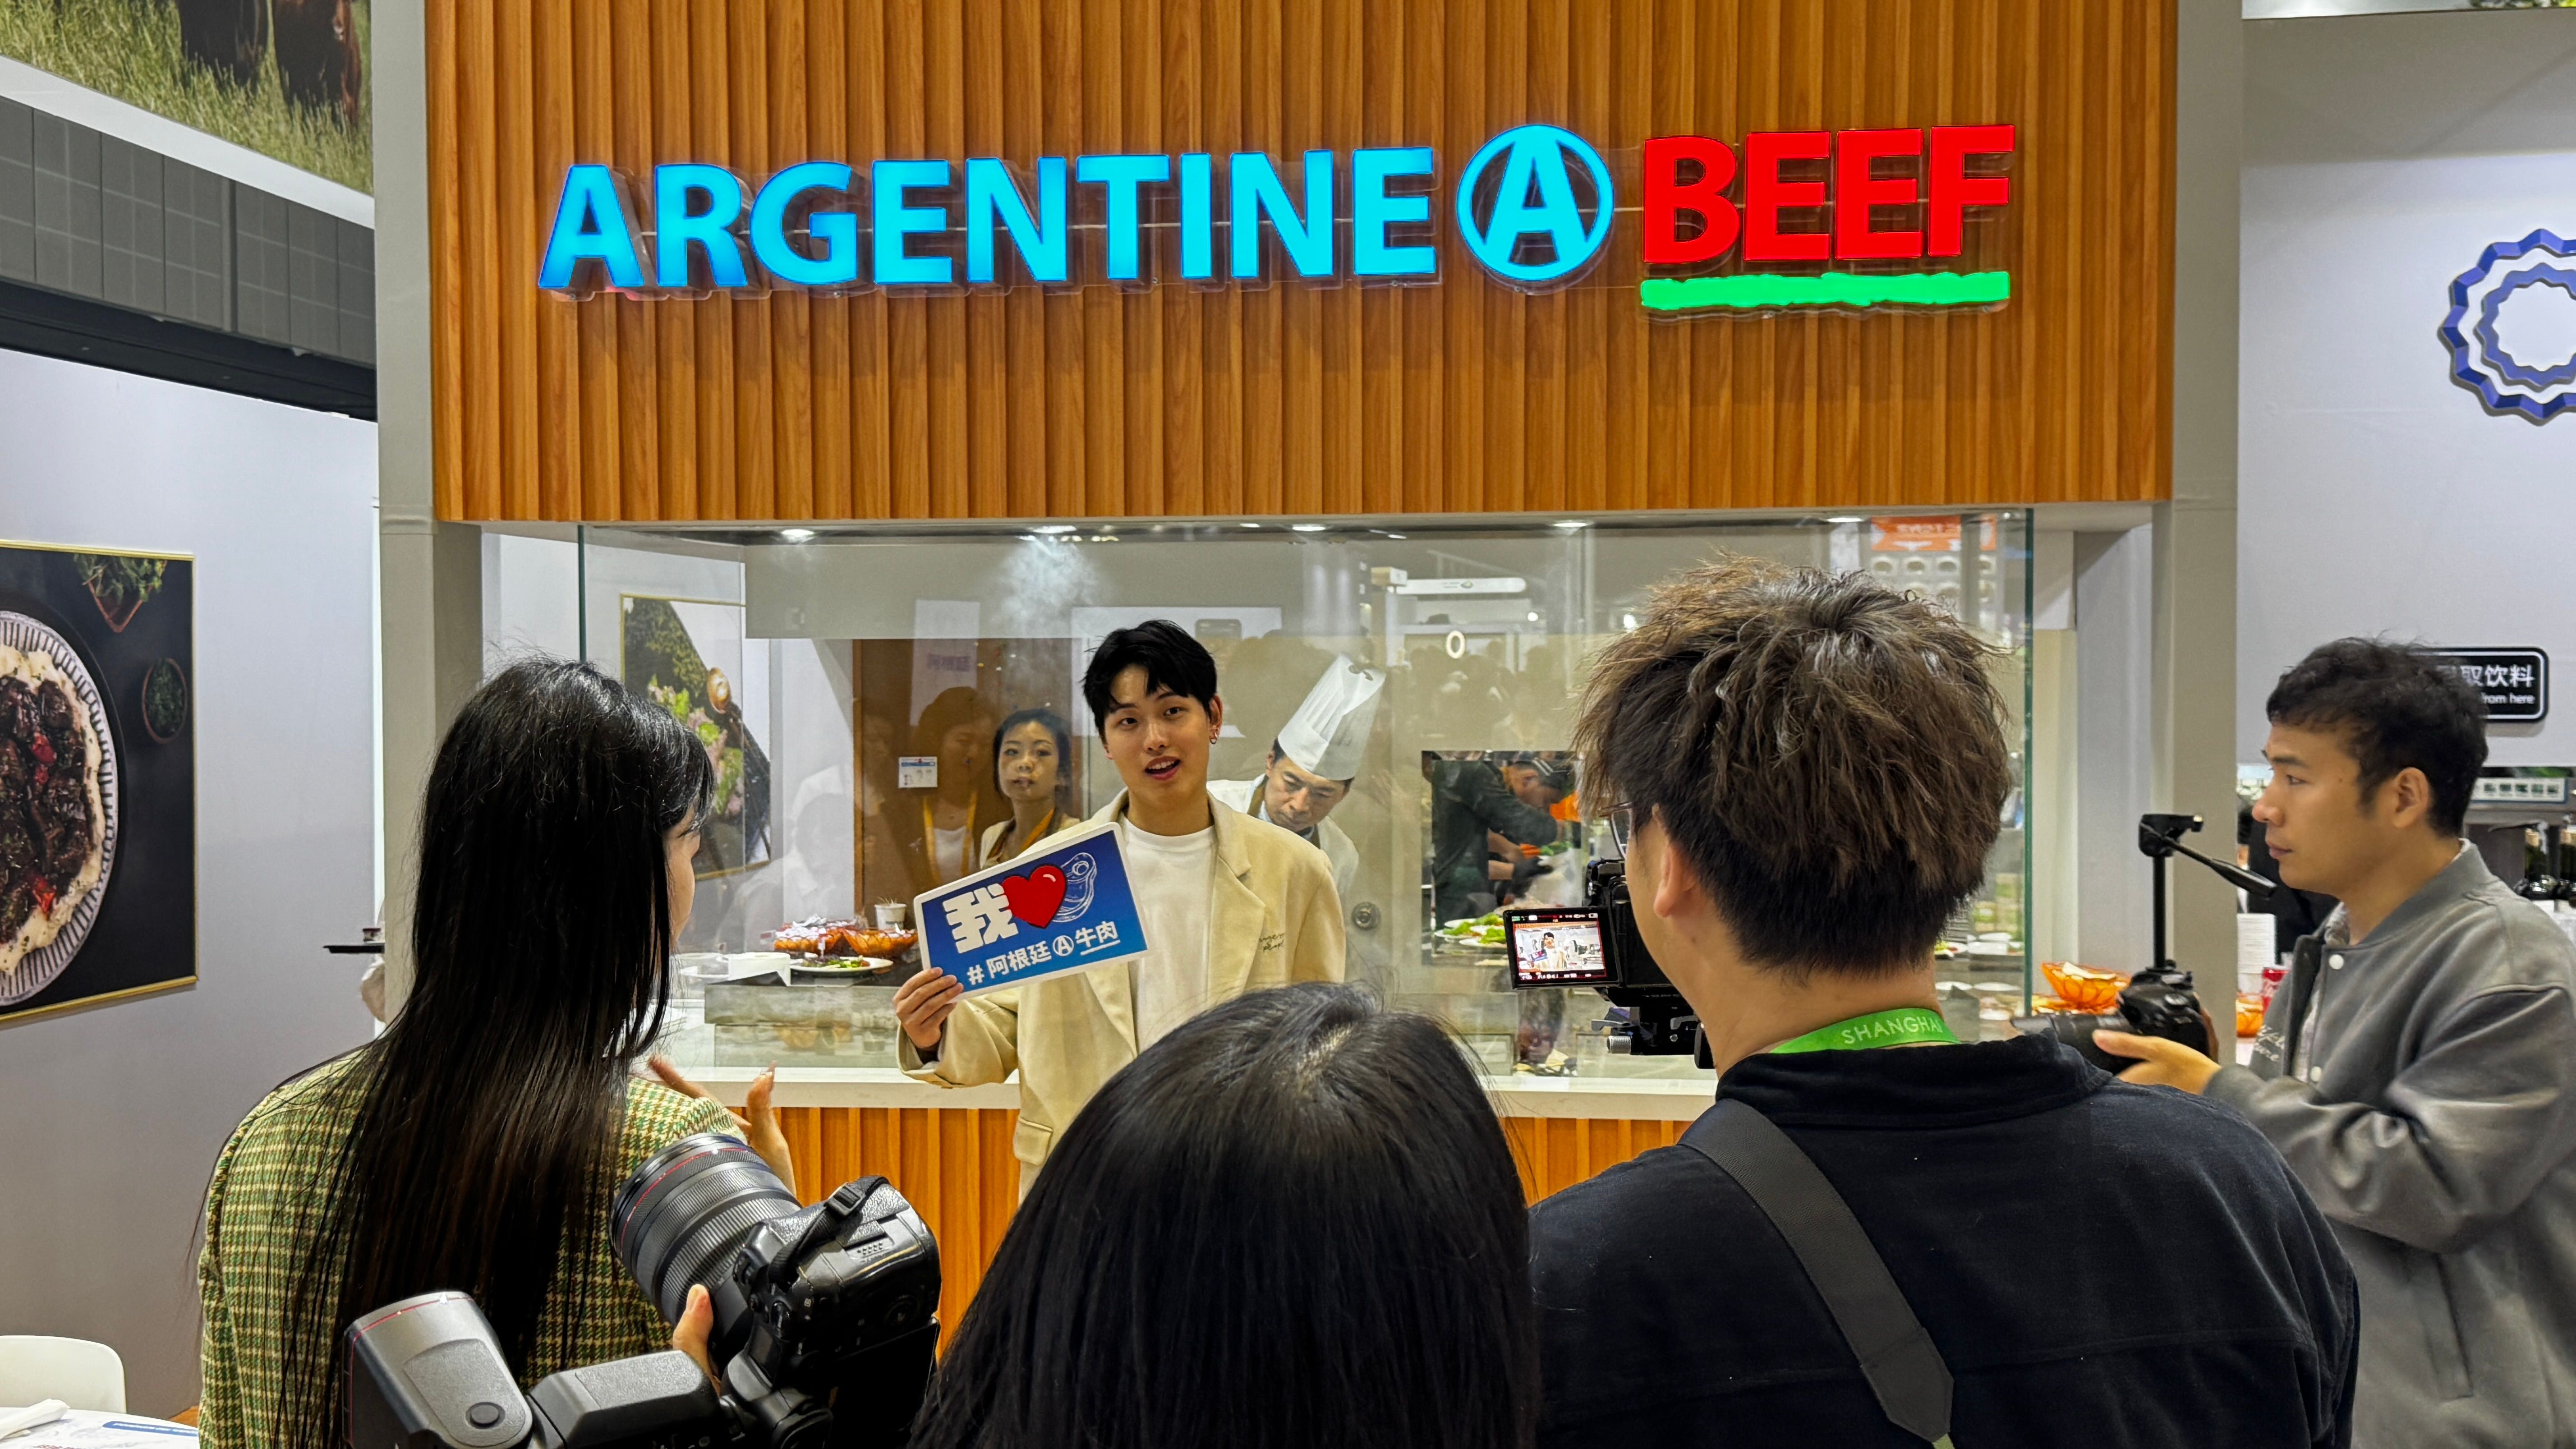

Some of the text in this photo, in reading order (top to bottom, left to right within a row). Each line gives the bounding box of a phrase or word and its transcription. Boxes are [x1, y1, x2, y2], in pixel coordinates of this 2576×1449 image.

[538, 124, 2015, 289] ARGENTINE A BEEF
[2509, 692, 2535, 704] here
[943, 883, 1019, 953] 我
